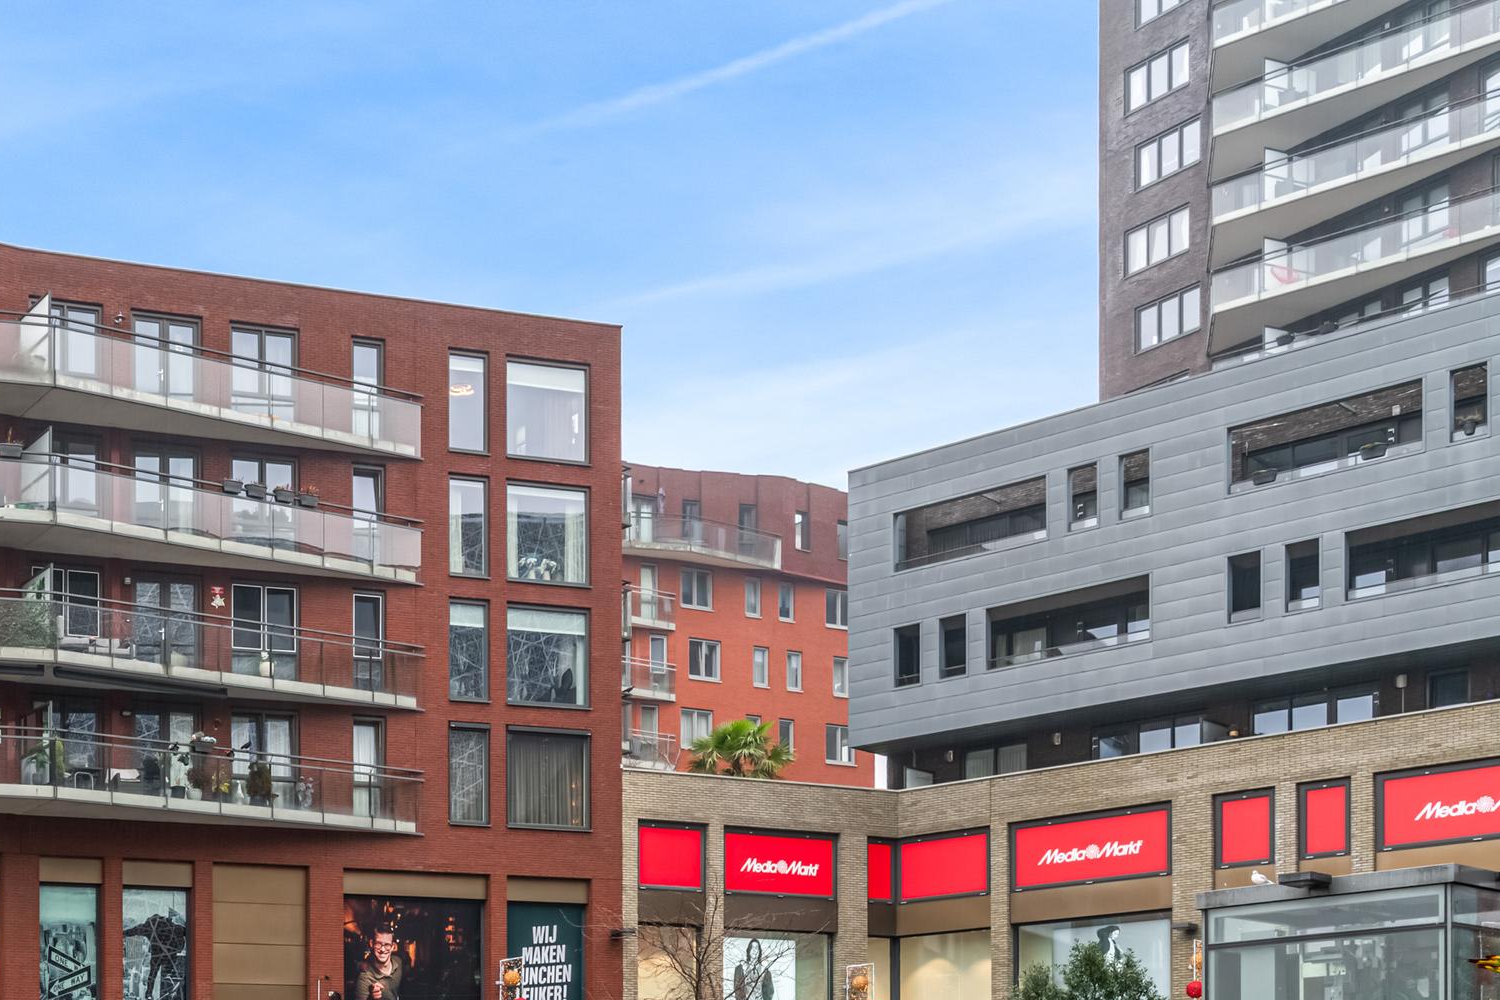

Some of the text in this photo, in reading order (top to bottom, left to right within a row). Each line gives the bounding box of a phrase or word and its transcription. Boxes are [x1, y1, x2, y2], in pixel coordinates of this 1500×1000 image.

[1414, 801, 1477, 821] Media
[1037, 840, 1143, 866] Media Markt
[740, 857, 820, 877] Media Markt
[532, 925, 557, 944] WIJ
[522, 944, 566, 965] MAKEN
[71, 974, 85, 985] WAY
[522, 964, 572, 985] UNCHEN
